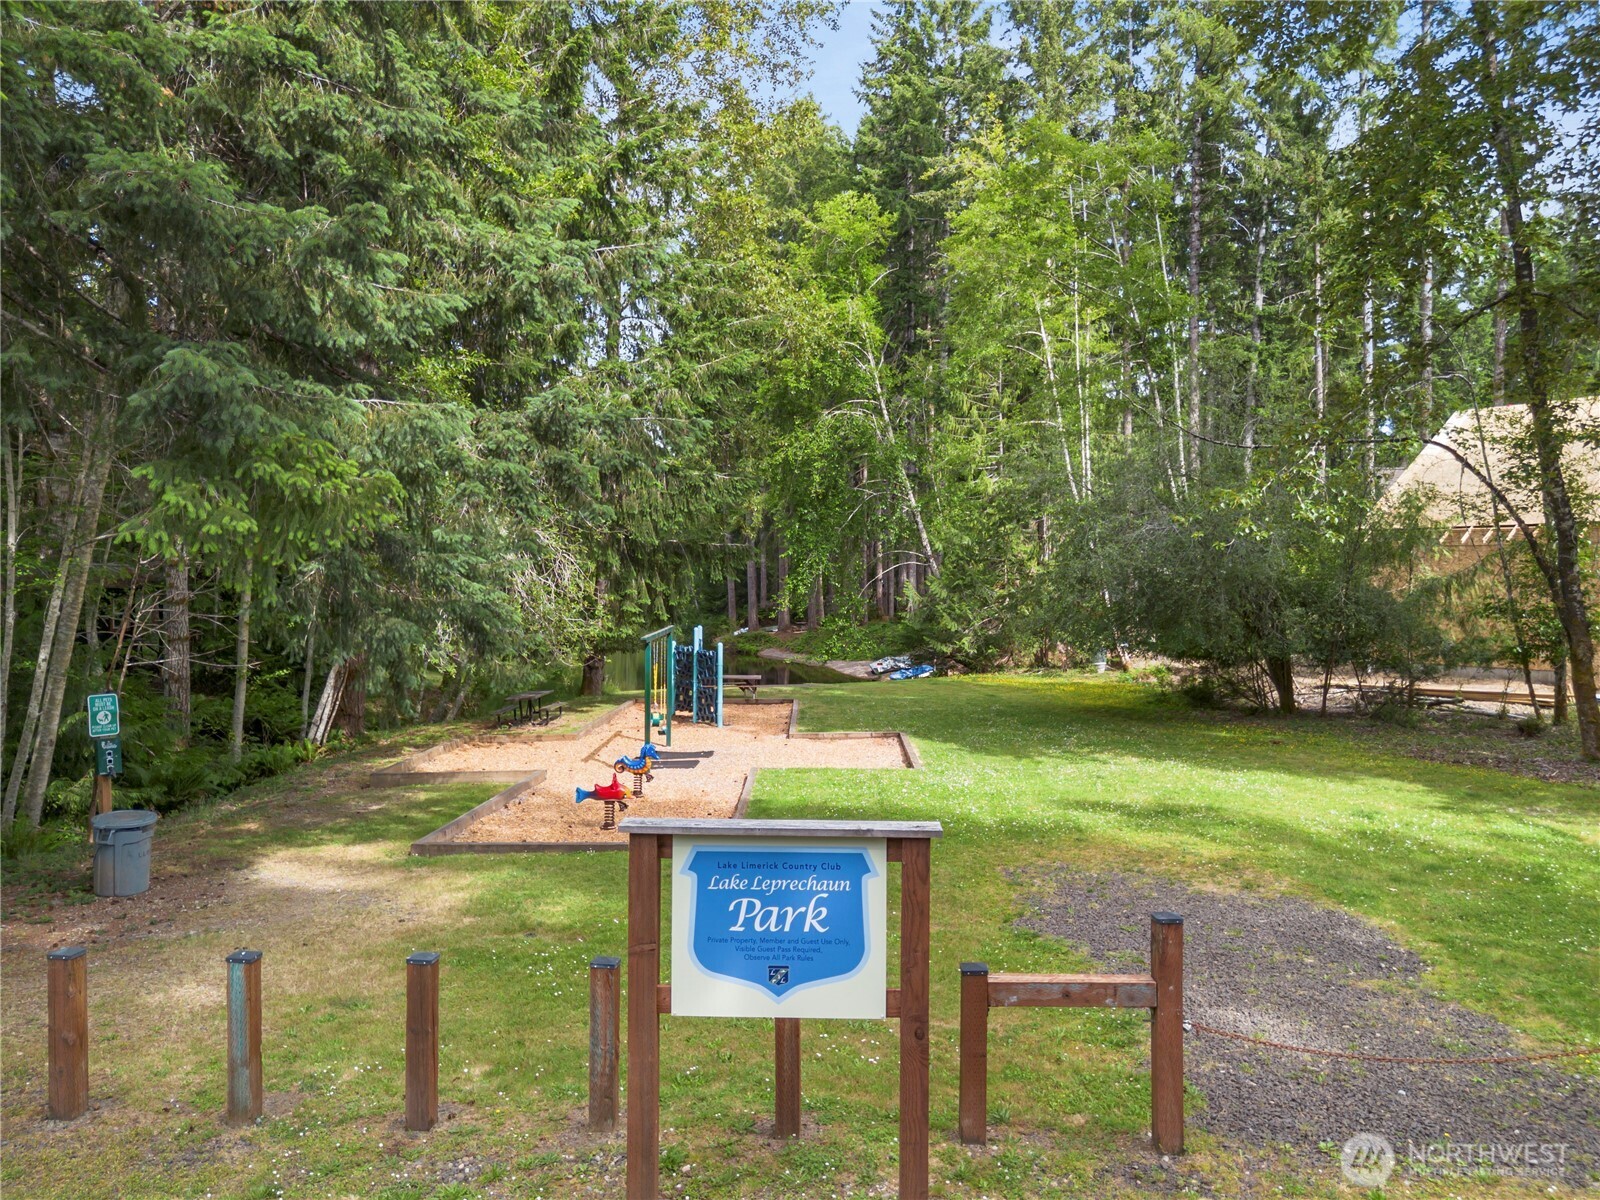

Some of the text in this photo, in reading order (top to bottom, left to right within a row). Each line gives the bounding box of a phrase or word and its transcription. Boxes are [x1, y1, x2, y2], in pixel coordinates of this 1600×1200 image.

[717, 861, 842, 872] Lake Limerick Country Club
[707, 873, 851, 896] Lake Leprechaun
[728, 893, 830, 933] Park
[707, 936, 729, 944] Private
[800, 937, 819, 945] Guest
[777, 945, 792, 953] Pass
[743, 953, 771, 961] Observe
